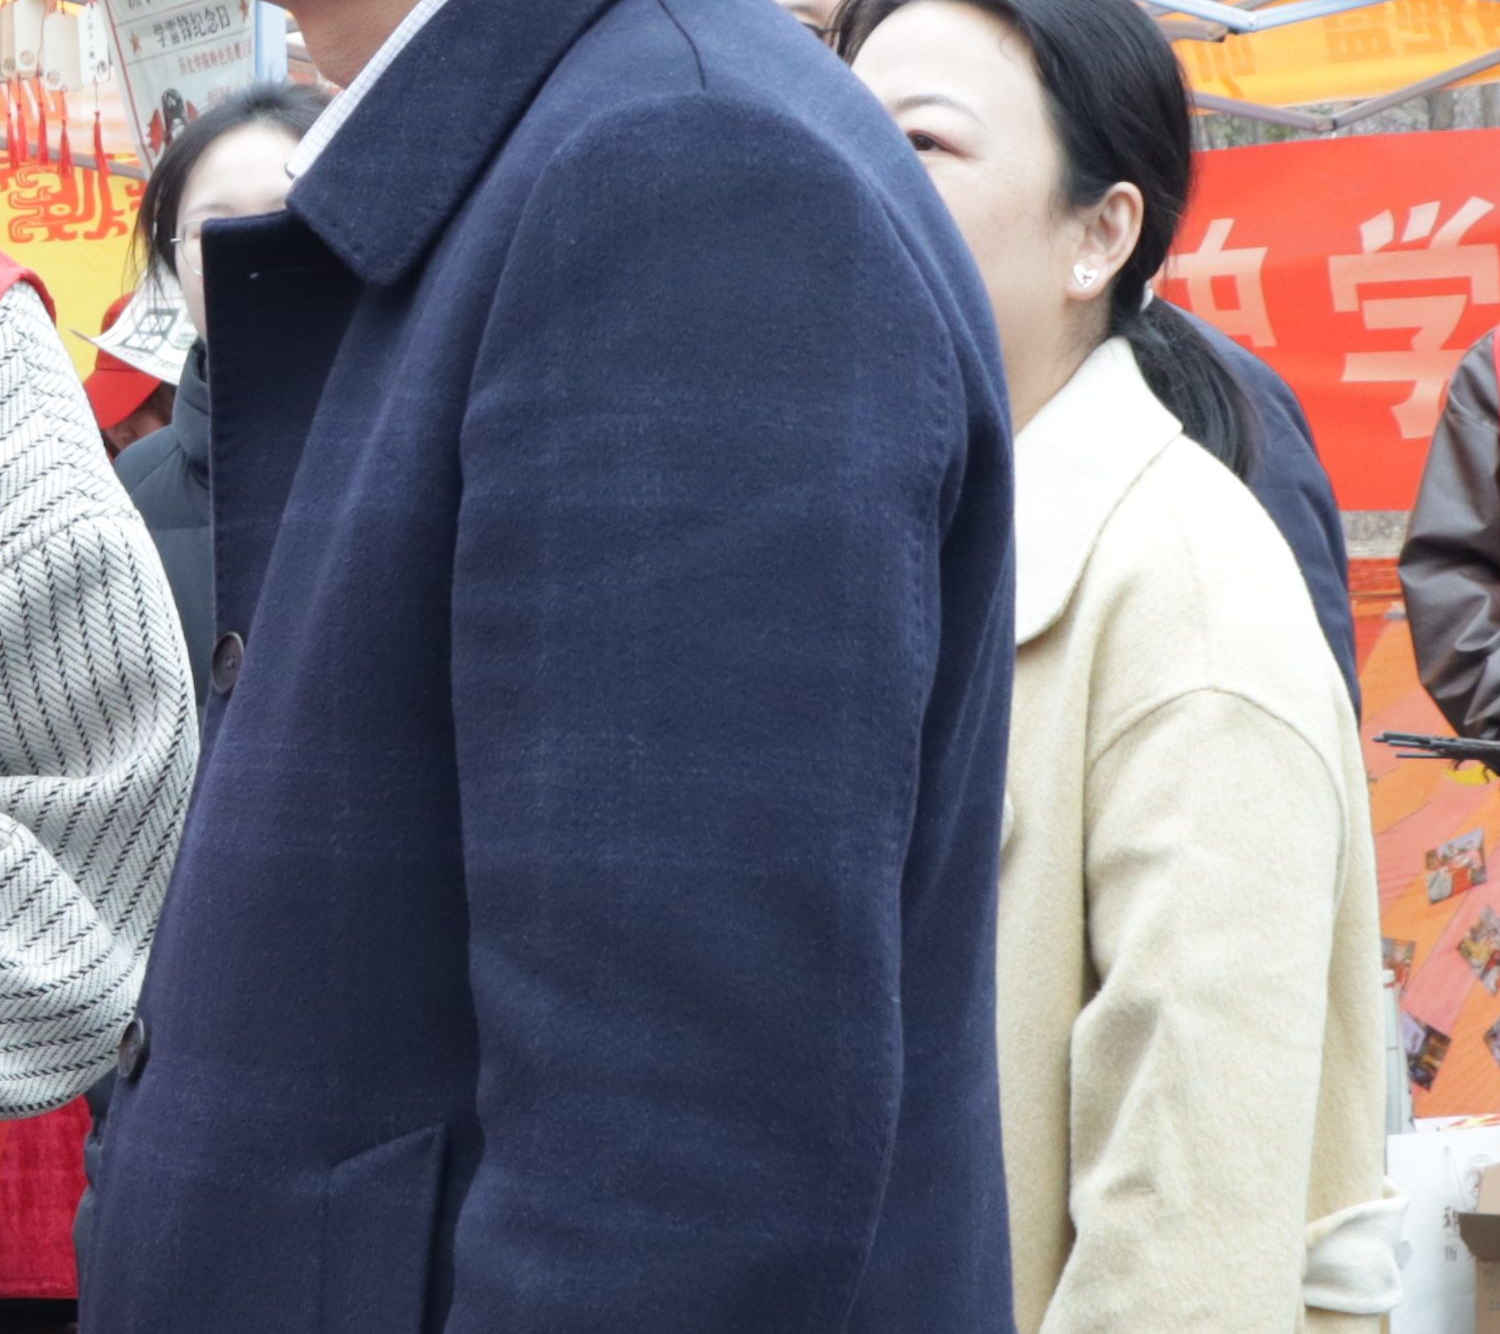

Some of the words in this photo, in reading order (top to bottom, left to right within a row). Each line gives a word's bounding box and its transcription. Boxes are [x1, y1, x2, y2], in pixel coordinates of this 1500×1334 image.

[153, 4, 231, 49] 学雷锋纪念日
